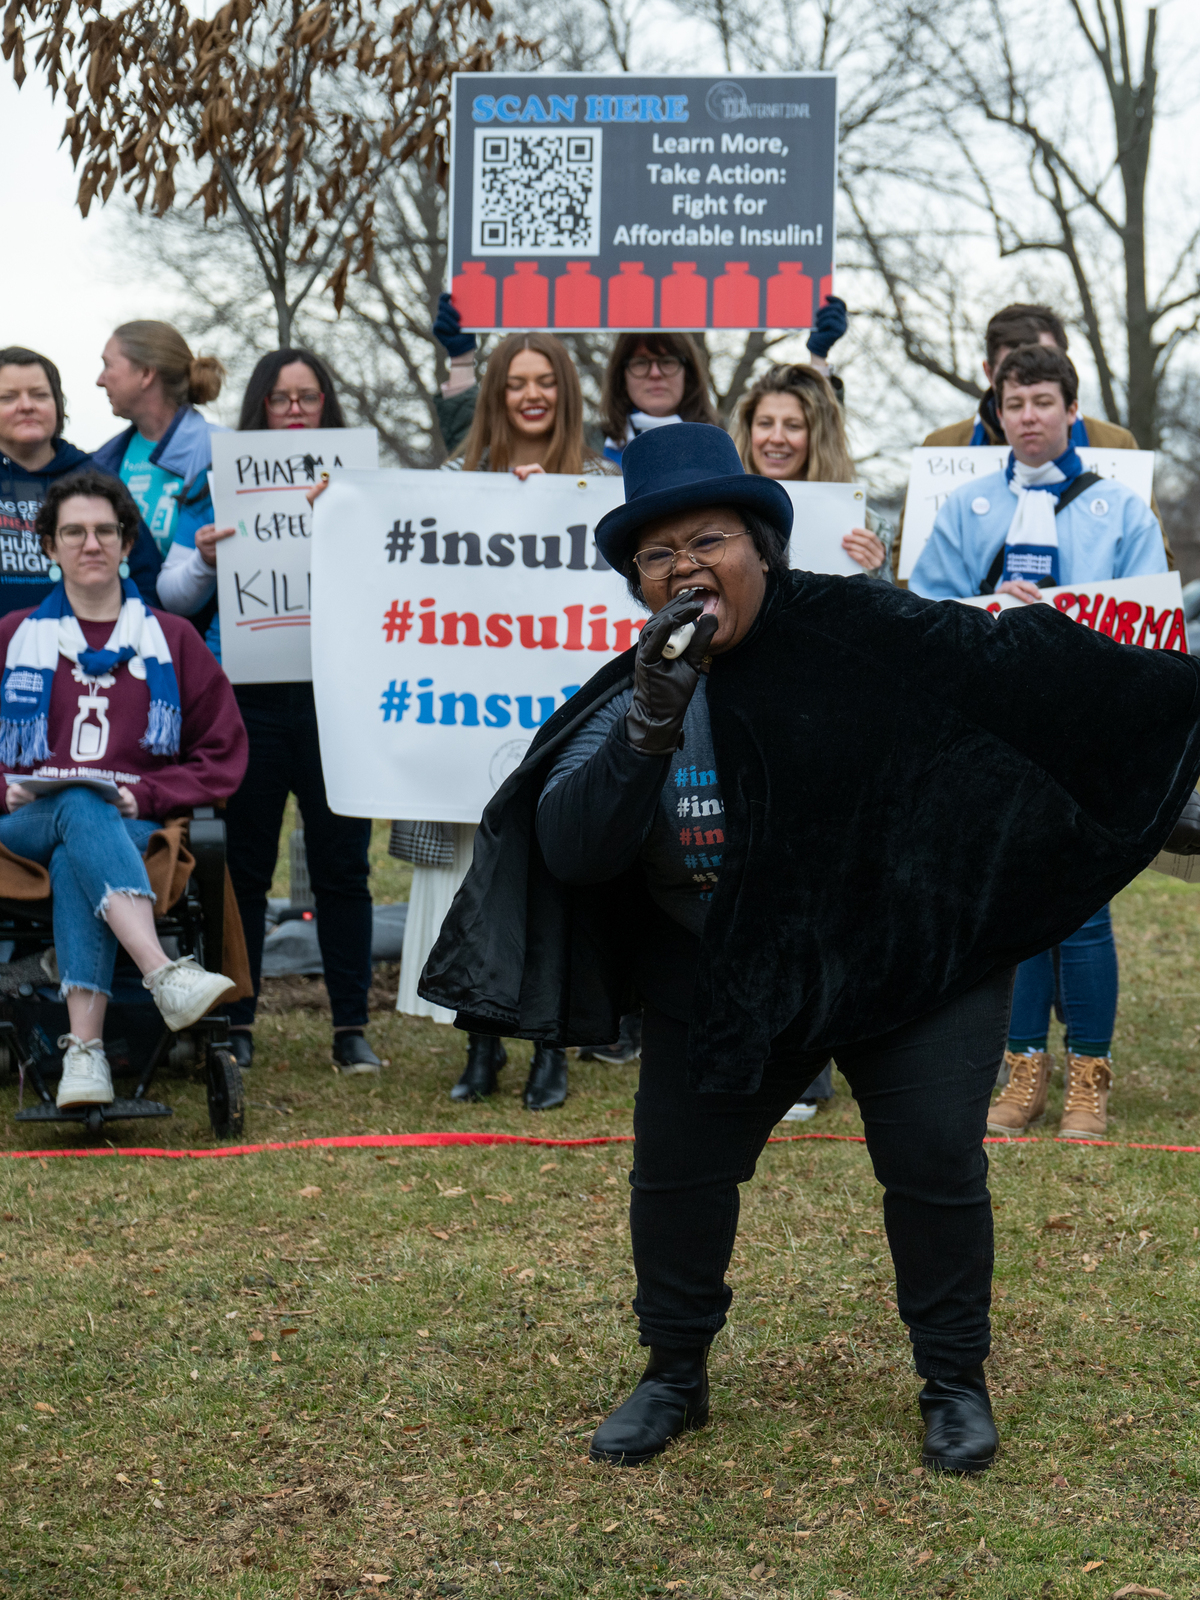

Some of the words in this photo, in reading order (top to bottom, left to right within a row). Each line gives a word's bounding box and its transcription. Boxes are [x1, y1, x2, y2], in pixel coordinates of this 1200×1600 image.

[472, 94, 577, 123] SCAN
[584, 94, 690, 123] HERE
[652, 132, 715, 155] Learn
[720, 132, 790, 158] More,
[646, 163, 701, 185] Take
[705, 163, 787, 185] Action:
[671, 194, 729, 221] Fight
[733, 193, 768, 215] for
[612, 224, 735, 247] Affordable
[739, 224, 824, 247] Insulin!
[927, 456, 975, 476] BIG
[255, 511, 313, 542] GREE
[1053, 592, 1189, 655] PHARMA
